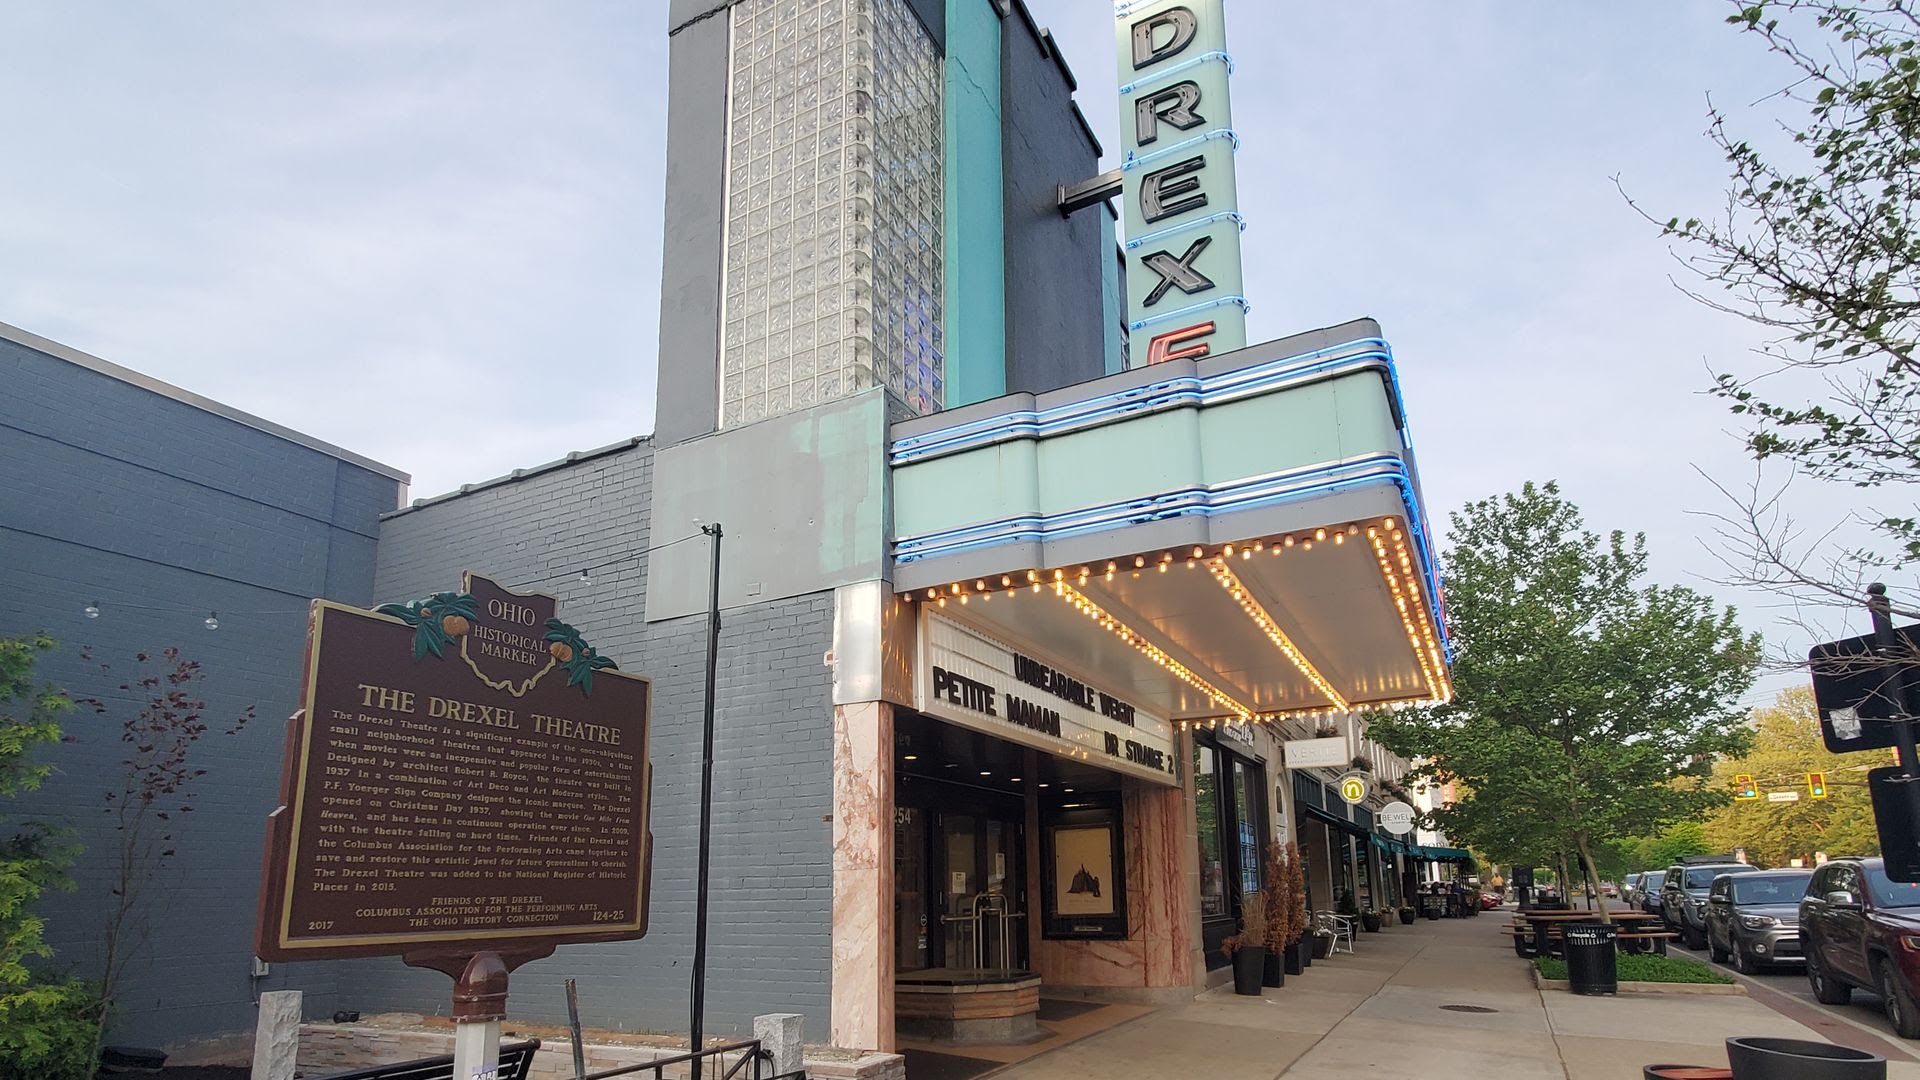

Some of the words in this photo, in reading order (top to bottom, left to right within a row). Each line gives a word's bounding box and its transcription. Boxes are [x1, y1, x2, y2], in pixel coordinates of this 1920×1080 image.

[1131, 5, 1217, 366] DREXE
[488, 599, 536, 626] OHIO
[474, 625, 547, 653] HISTORICAL
[481, 642, 537, 666] MARKER
[933, 666, 997, 716] PETITE
[1006, 693, 1062, 738] MAMAN
[1014, 652, 1096, 712] UNBEARABLE
[1100, 692, 1136, 728] WEIGHT
[357, 682, 415, 713] THE
[427, 696, 519, 729] DREXEL
[530, 713, 620, 745] THEATRE
[331, 709, 352, 720] The
[358, 713, 393, 726] Drexel
[399, 719, 438, 732] Theatre
[442, 726, 450, 734] is
[465, 729, 512, 742] significant
[516, 738, 548, 748] example
[329, 725, 358, 735] small
[366, 730, 434, 745] neighborhood
[442, 739, 480, 750] theatres
[487, 745, 504, 754] that
[509, 749, 546, 759] appeared
[1104, 731, 1120, 757] DR
[1125, 739, 1165, 771] STRANGE
[1167, 754, 1175, 775] 2
[326, 751, 376, 765] Designed
[382, 757, 395, 768] by
[402, 761, 448, 772] architect
[454, 765, 484, 776] Robert
[536, 775, 549, 783] the
[329, 739, 357, 749] when
[362, 743, 397, 754] movies
[402, 748, 426, 757] were
[429, 751, 441, 759] an
[445, 752, 496, 765] inexpensive
[518, 762, 549, 771] popular
[325, 765, 350, 776] 1937
[357, 768, 369, 778] in
[387, 773, 447, 785] combination
[452, 779, 462, 787] of
[467, 780, 483, 788] Art
[488, 782, 509, 791] Deco
[513, 785, 528, 793] and
[532, 786, 546, 794] Art
[347, 782, 390, 795] Yoerger
[393, 786, 416, 797] Sign
[420, 788, 462, 801] Company
[466, 792, 504, 803] designed
[507, 796, 521, 804] the
[524, 797, 549, 806] iconic
[321, 796, 362, 805] opened
[368, 799, 382, 807] on
[388, 799, 438, 811] Christmas
[444, 803, 463, 813] Day
[499, 808, 533, 819] showing
[539, 810, 552, 818] the
[319, 823, 345, 832] with
[350, 825, 368, 834] the
[374, 826, 413, 836] theatre
[418, 828, 451, 839] falling
[470, 831, 492, 839] hard
[528, 833, 558, 842] Friends
[366, 813, 386, 821] and
[391, 813, 408, 822] has
[413, 814, 438, 824] been
[442, 816, 452, 825] in
[455, 819, 503, 827] continuous
[507, 822, 546, 830] operation
[318, 838, 336, 847] the
[342, 839, 392, 849] Columbus
[397, 841, 453, 851] Association
[458, 843, 472, 852] for
[476, 844, 491, 852] the
[495, 844, 542, 855] Performing
[315, 854, 340, 862] save
[345, 854, 365, 862] and
[369, 854, 407, 863] restore
[411, 855, 430, 864] this
[434, 856, 469, 864] artistic
[472, 856, 497, 866] jewel
[500, 857, 514, 865] for
[515, 857, 542, 866] future
[313, 867, 335, 877] The
[341, 868, 378, 877] Drexel
[384, 868, 424, 877] Theatre
[452, 870, 480, 878] added
[484, 870, 494, 878] to
[497, 870, 512, 878] the
[515, 870, 549, 878] National
[312, 882, 348, 891] Places
[354, 882, 365, 891] in
[354, 907, 411, 917] COLUMBUS
[414, 905, 480, 915] ASSOCIATION
[484, 905, 501, 914] FOR
[504, 904, 522, 913] THE
[526, 903, 575, 912] PERFORMING
[430, 896, 471, 905] FRIENDS
[474, 896, 486, 904] OF
[489, 895, 507, 904] THE
[510, 895, 543, 904] DREXEL
[308, 920, 334, 930] 2017
[408, 917, 428, 926] THE
[432, 916, 458, 926] OHIO
[462, 915, 502, 924] HISTORY
[505, 913, 558, 923] CONNECTION
